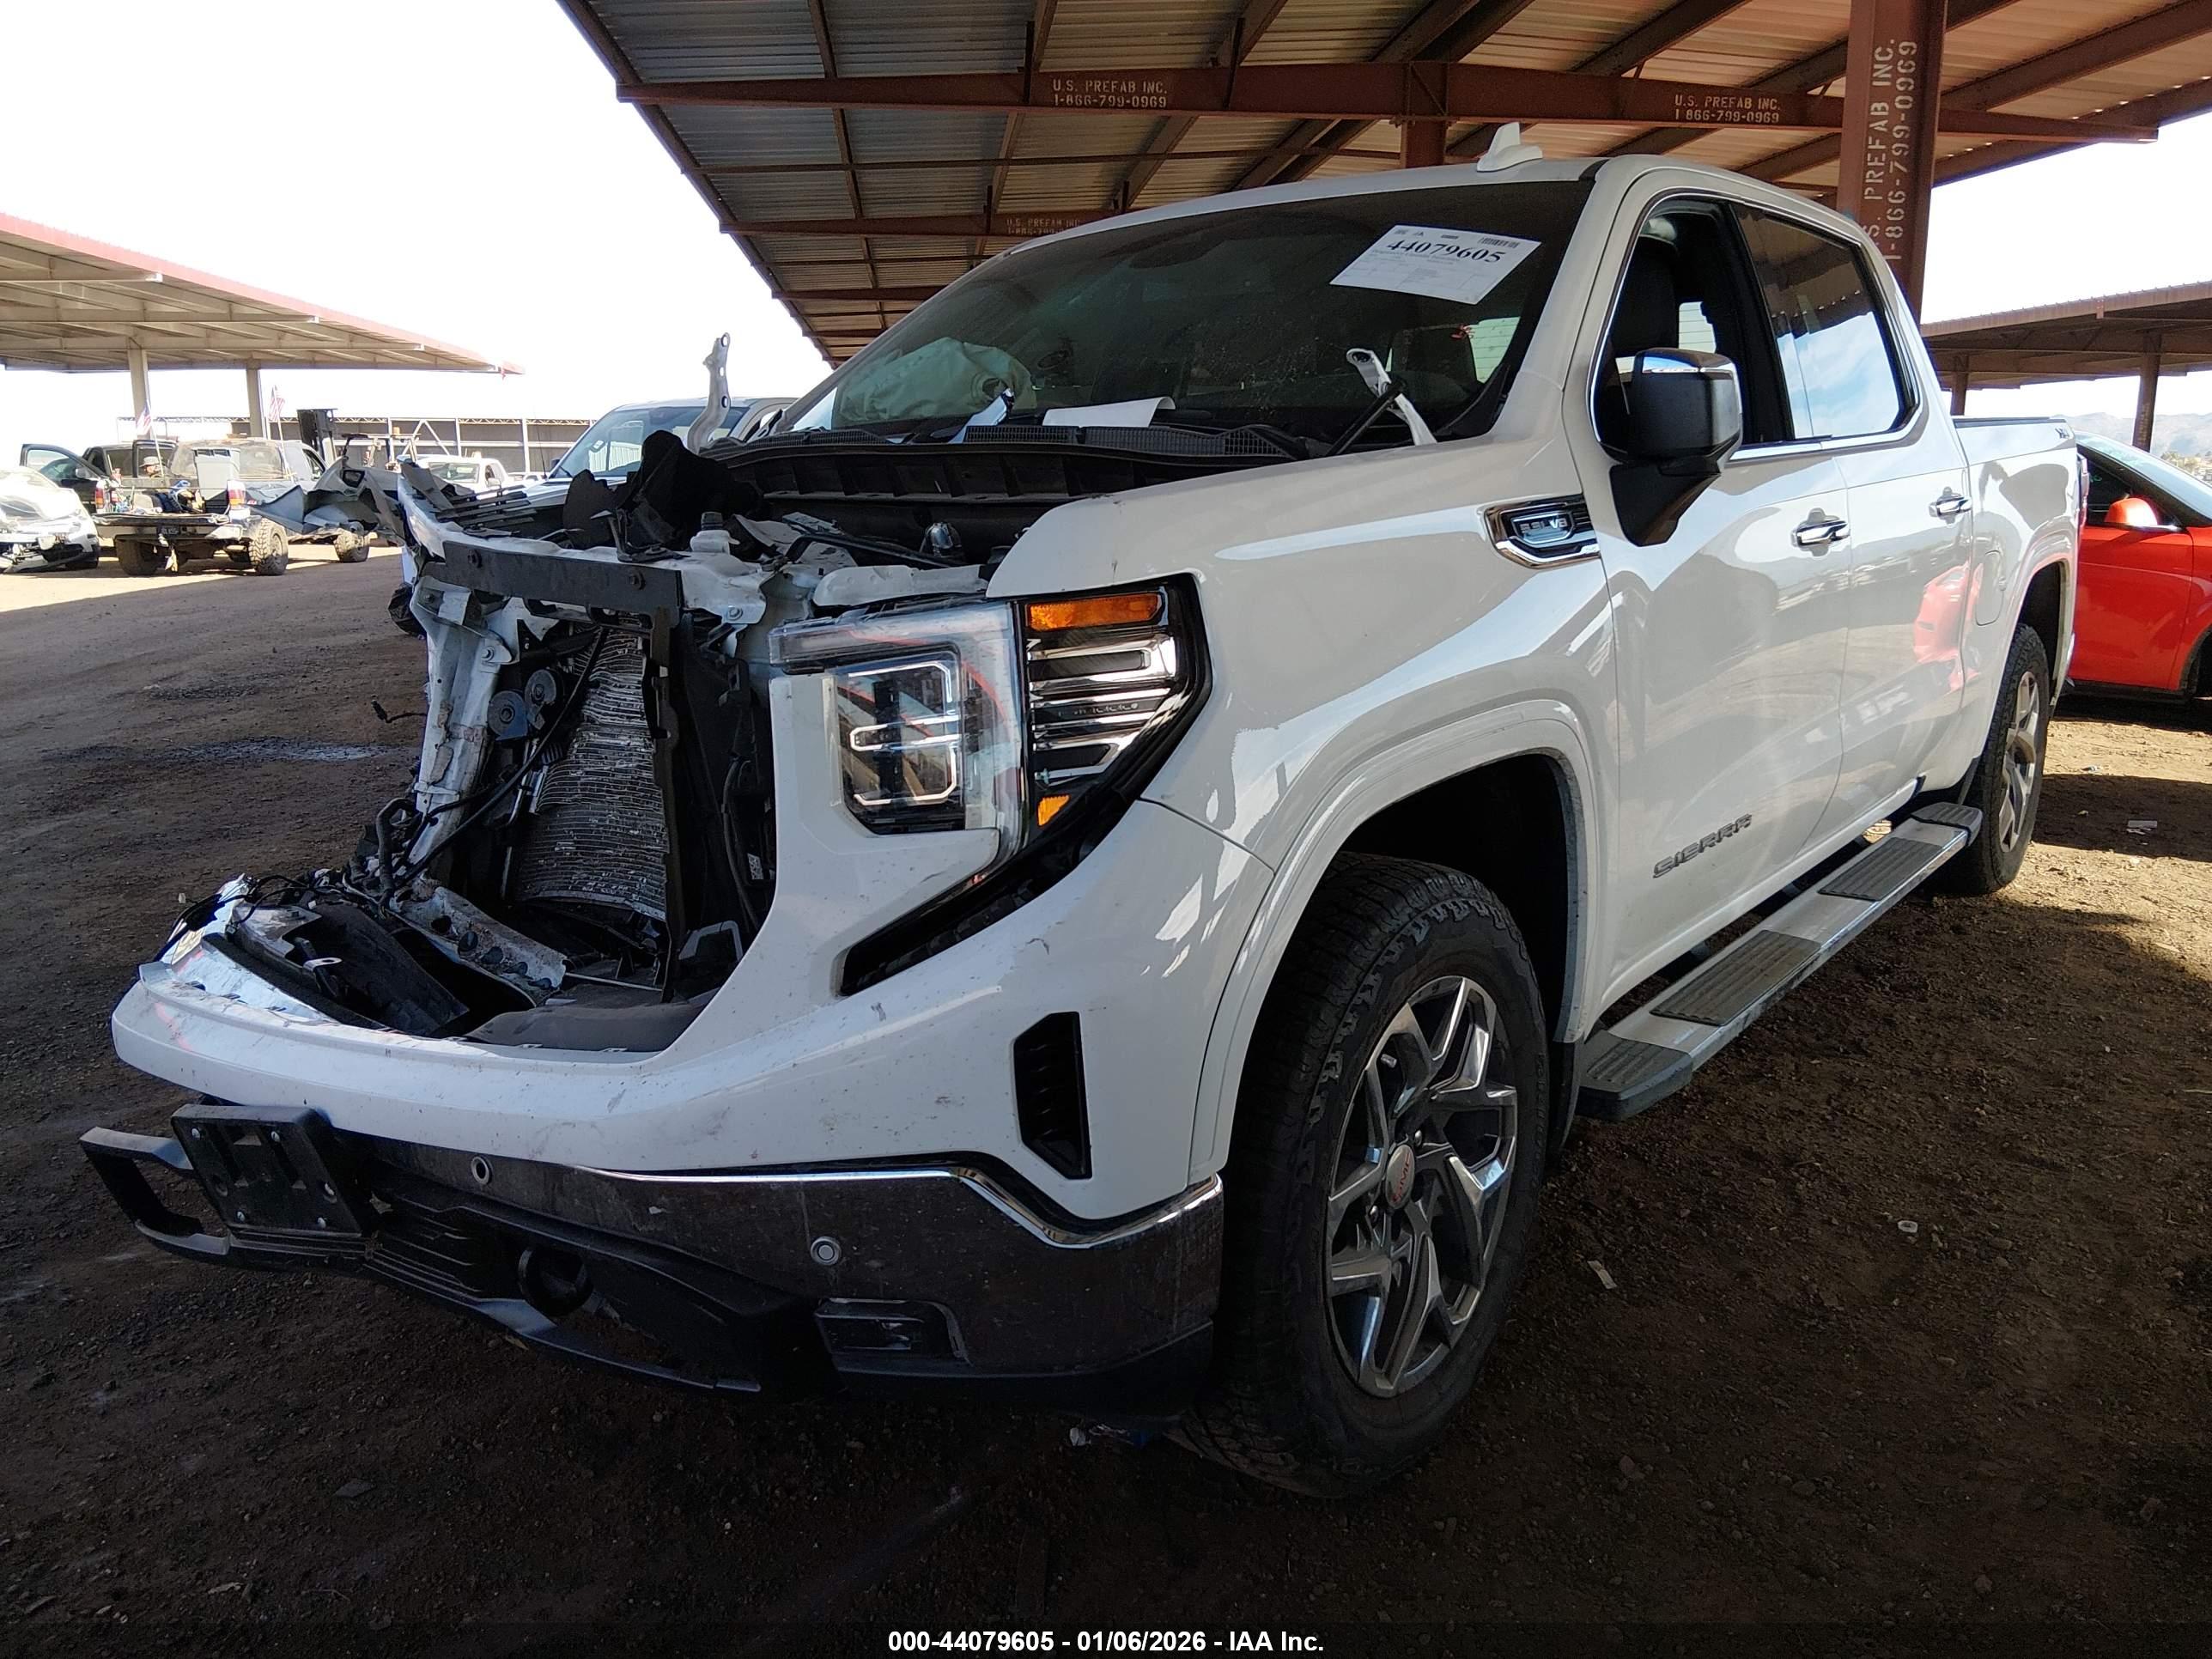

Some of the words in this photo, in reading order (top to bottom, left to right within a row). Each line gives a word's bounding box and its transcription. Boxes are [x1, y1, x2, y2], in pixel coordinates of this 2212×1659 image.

[1873, 39, 1895, 87] INC.
[1053, 79, 1078, 92] U.S.
[1085, 81, 1136, 94] PREFAB
[1143, 81, 1168, 94] INC.
[1054, 94, 1167, 108] 1-866-799-0969
[1674, 94, 1698, 107] U.S.
[1705, 95, 1753, 110] PREFAB
[1758, 97, 1781, 111] INC.
[1864, 100, 1889, 200] PREFAB
[1885, 41, 1917, 260] 1-866-799-0969
[1387, 240, 1507, 263] 44079605
[1653, 813, 1753, 878] SIERRA
